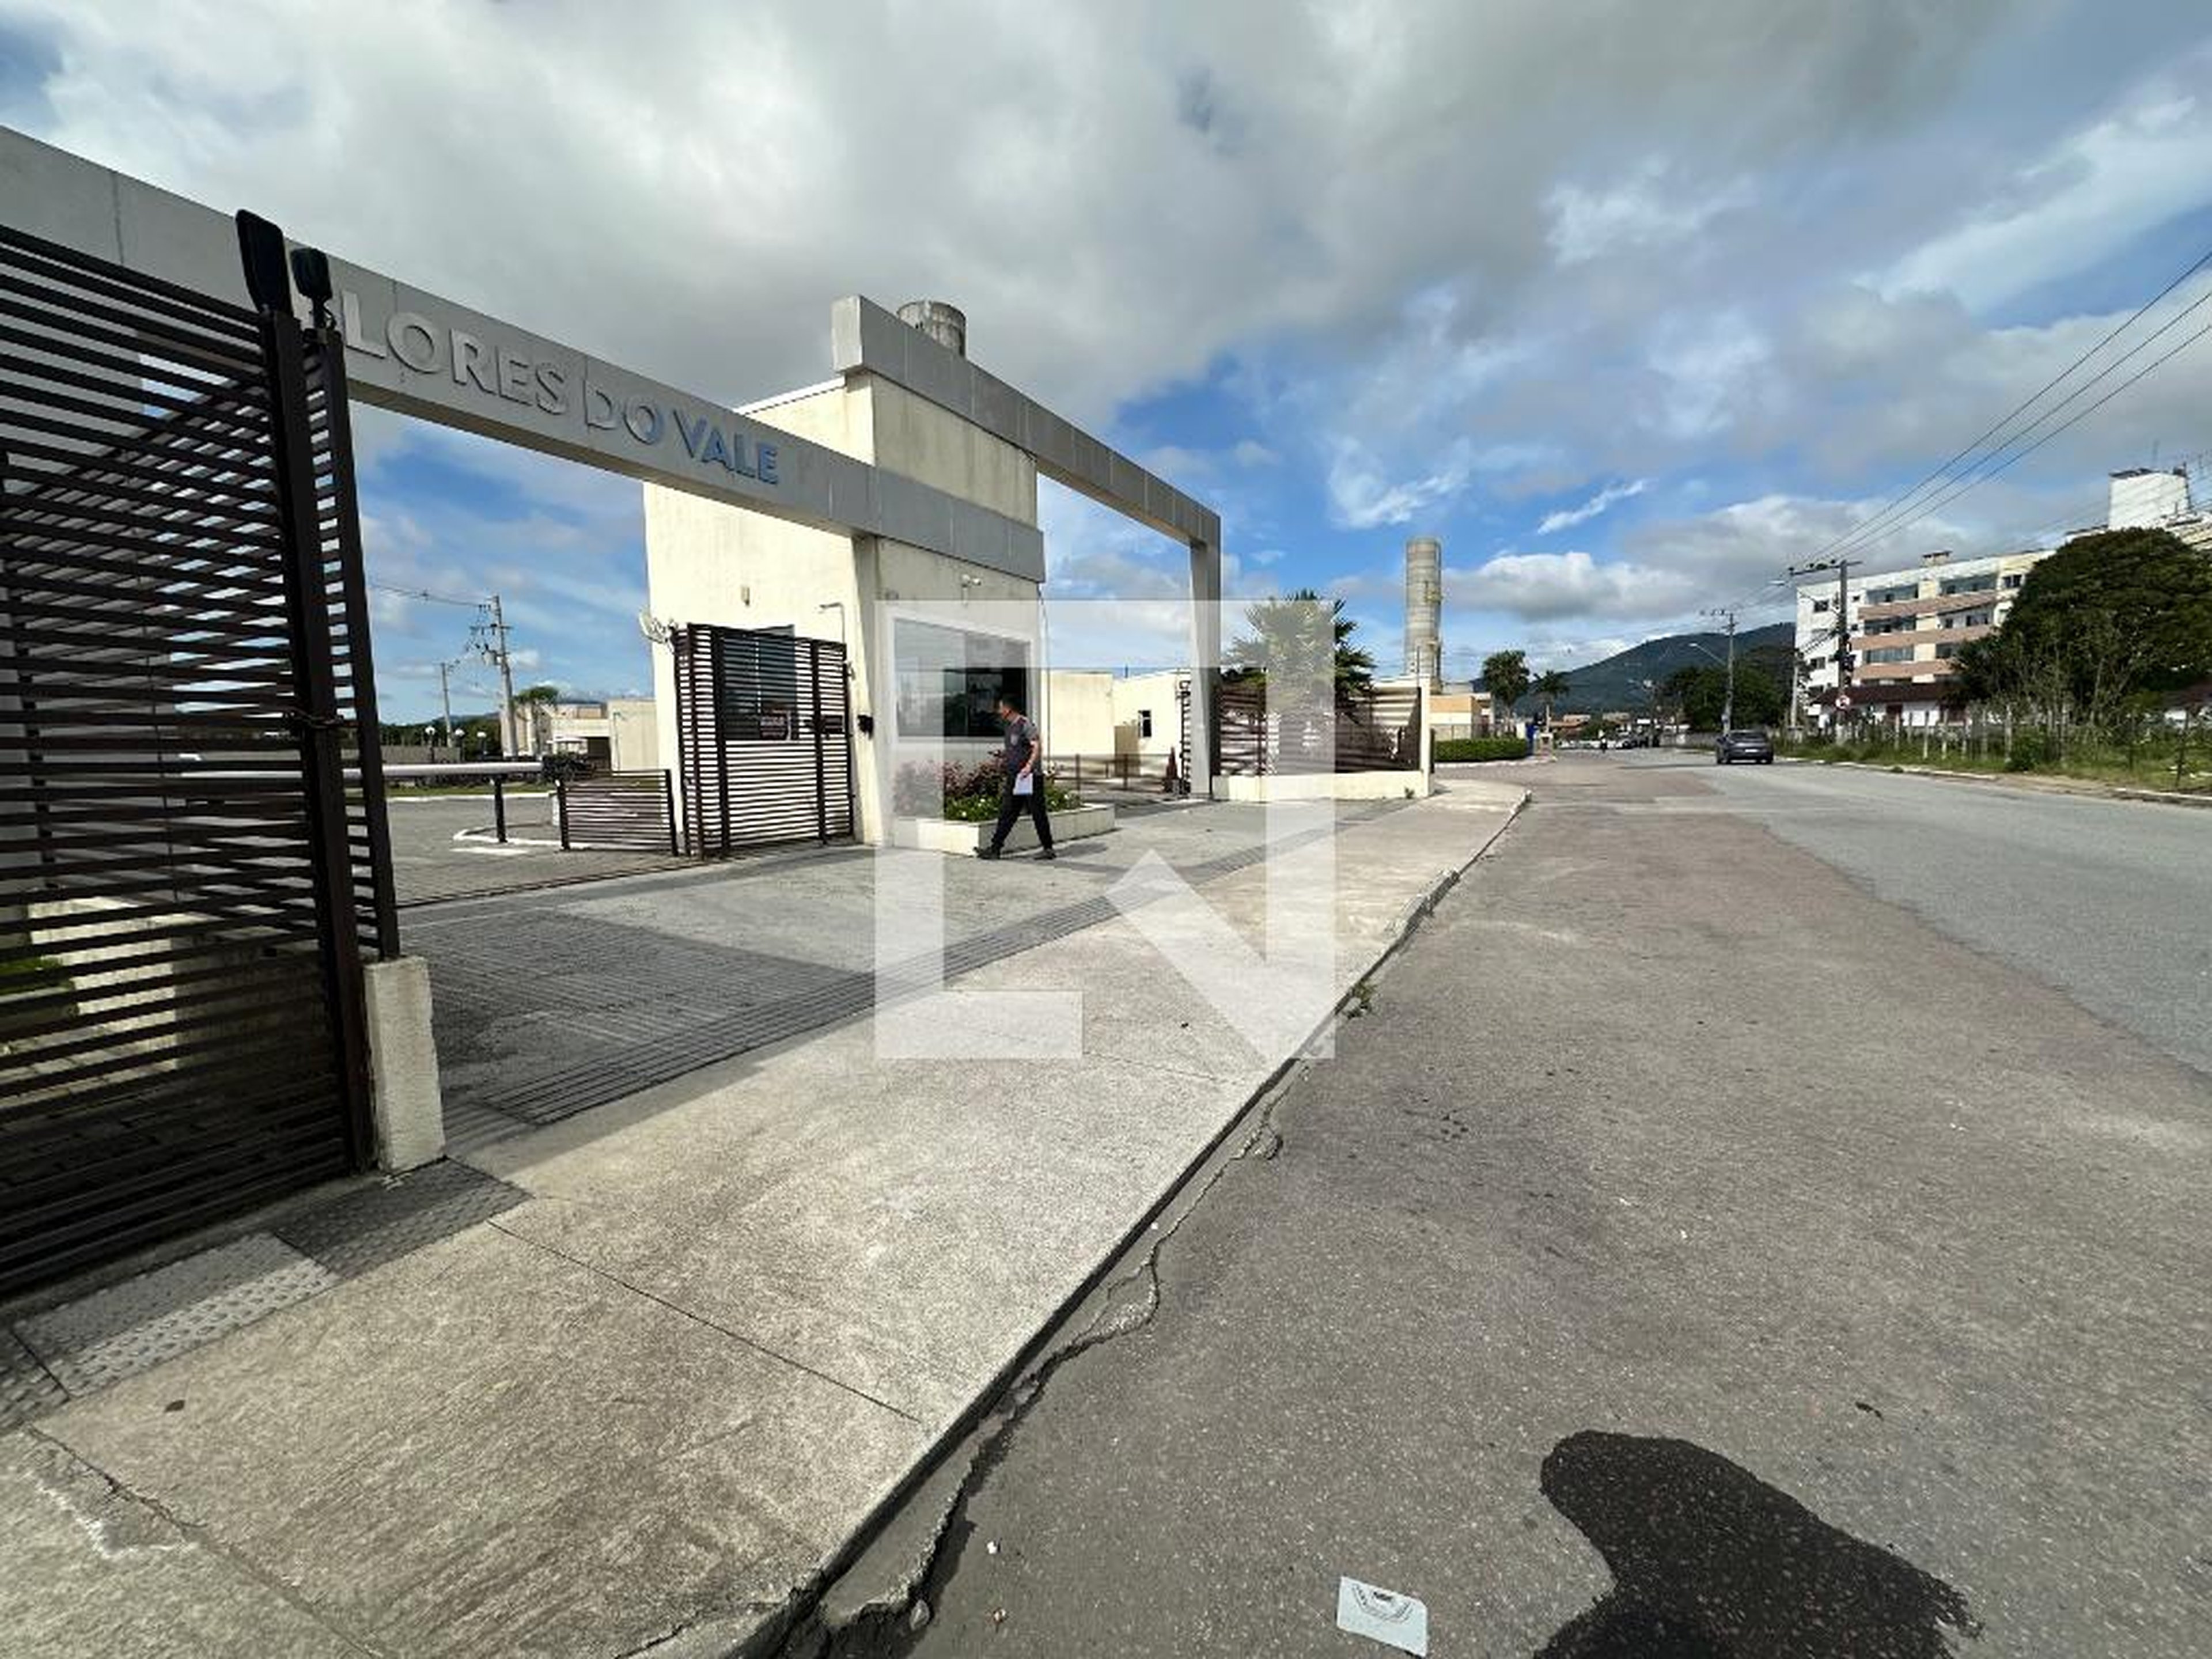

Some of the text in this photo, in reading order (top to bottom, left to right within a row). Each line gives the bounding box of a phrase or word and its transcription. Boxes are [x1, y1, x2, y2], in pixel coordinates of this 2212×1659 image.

[342, 290, 778, 485] LORES DO VALE
